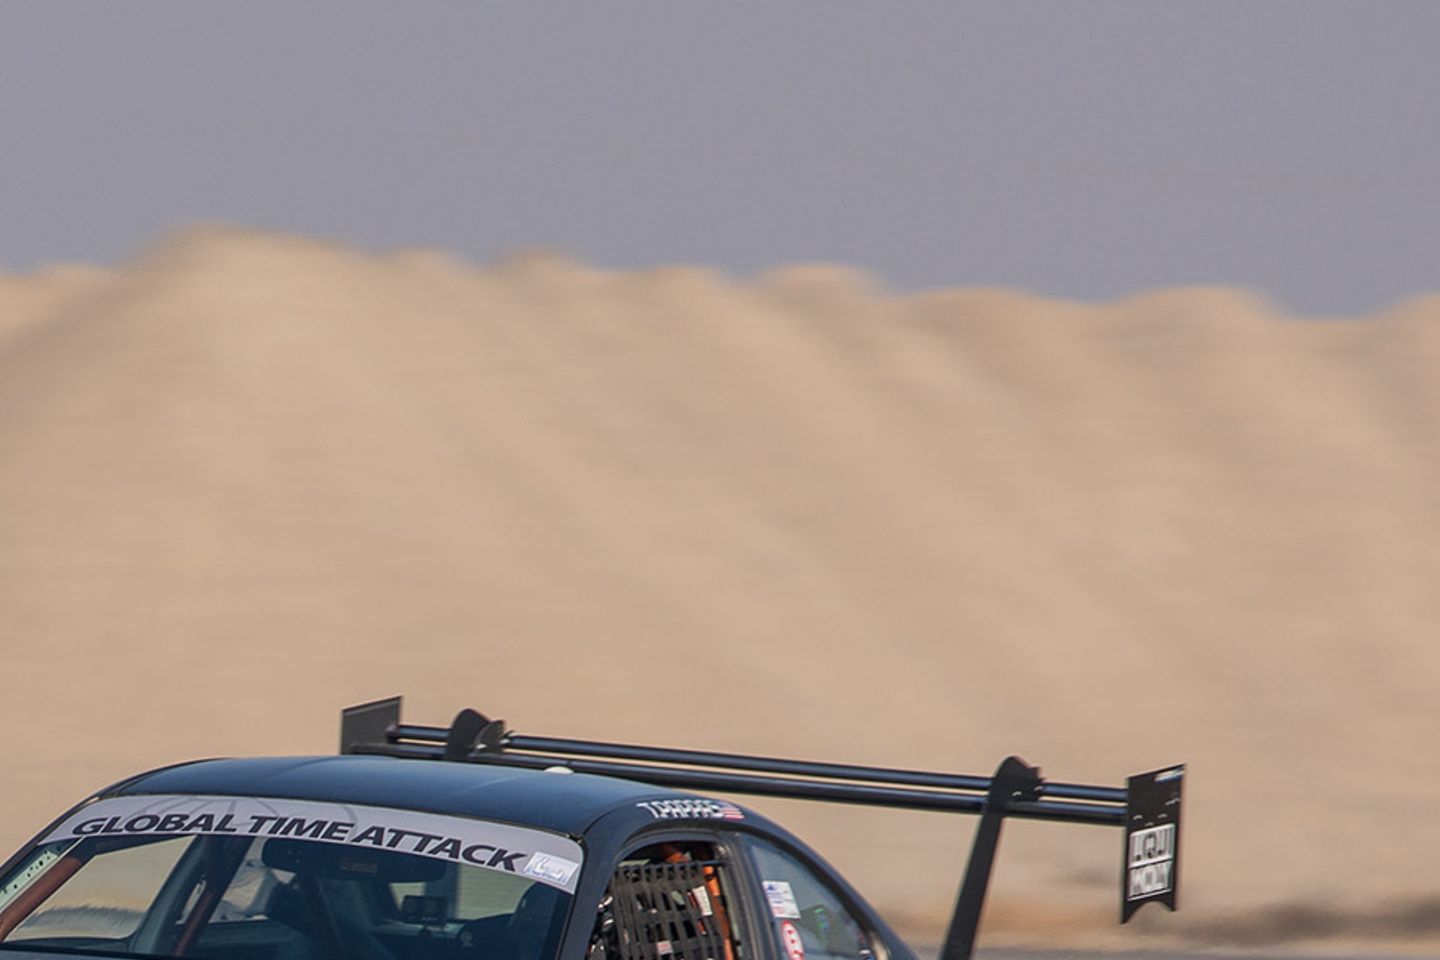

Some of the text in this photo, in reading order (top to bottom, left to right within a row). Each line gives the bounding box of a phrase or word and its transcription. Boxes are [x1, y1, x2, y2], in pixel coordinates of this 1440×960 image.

[72, 813, 237, 835] GLOBAL
[247, 815, 354, 842] TIME
[351, 825, 527, 872] ATTACK
